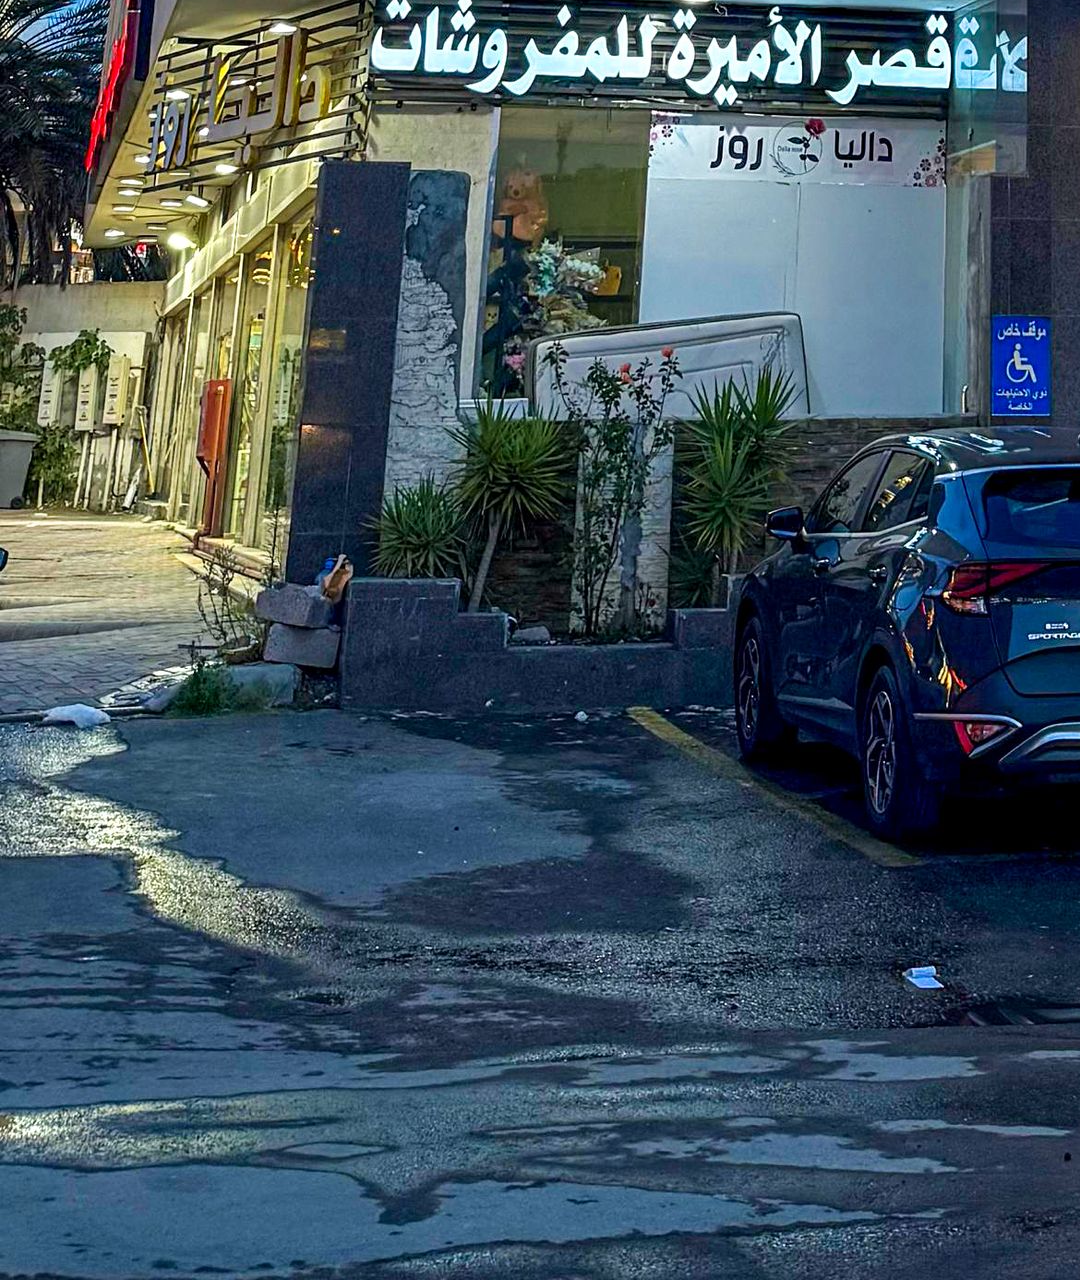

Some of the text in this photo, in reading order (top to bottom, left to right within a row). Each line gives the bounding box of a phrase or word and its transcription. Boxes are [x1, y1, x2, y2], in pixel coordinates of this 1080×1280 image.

[667, 6, 822, 106] الأميرة
[825, 14, 951, 105] قصر
[710, 125, 893, 170] داليا روز
[997, 320, 1047, 341] موقف خاص
